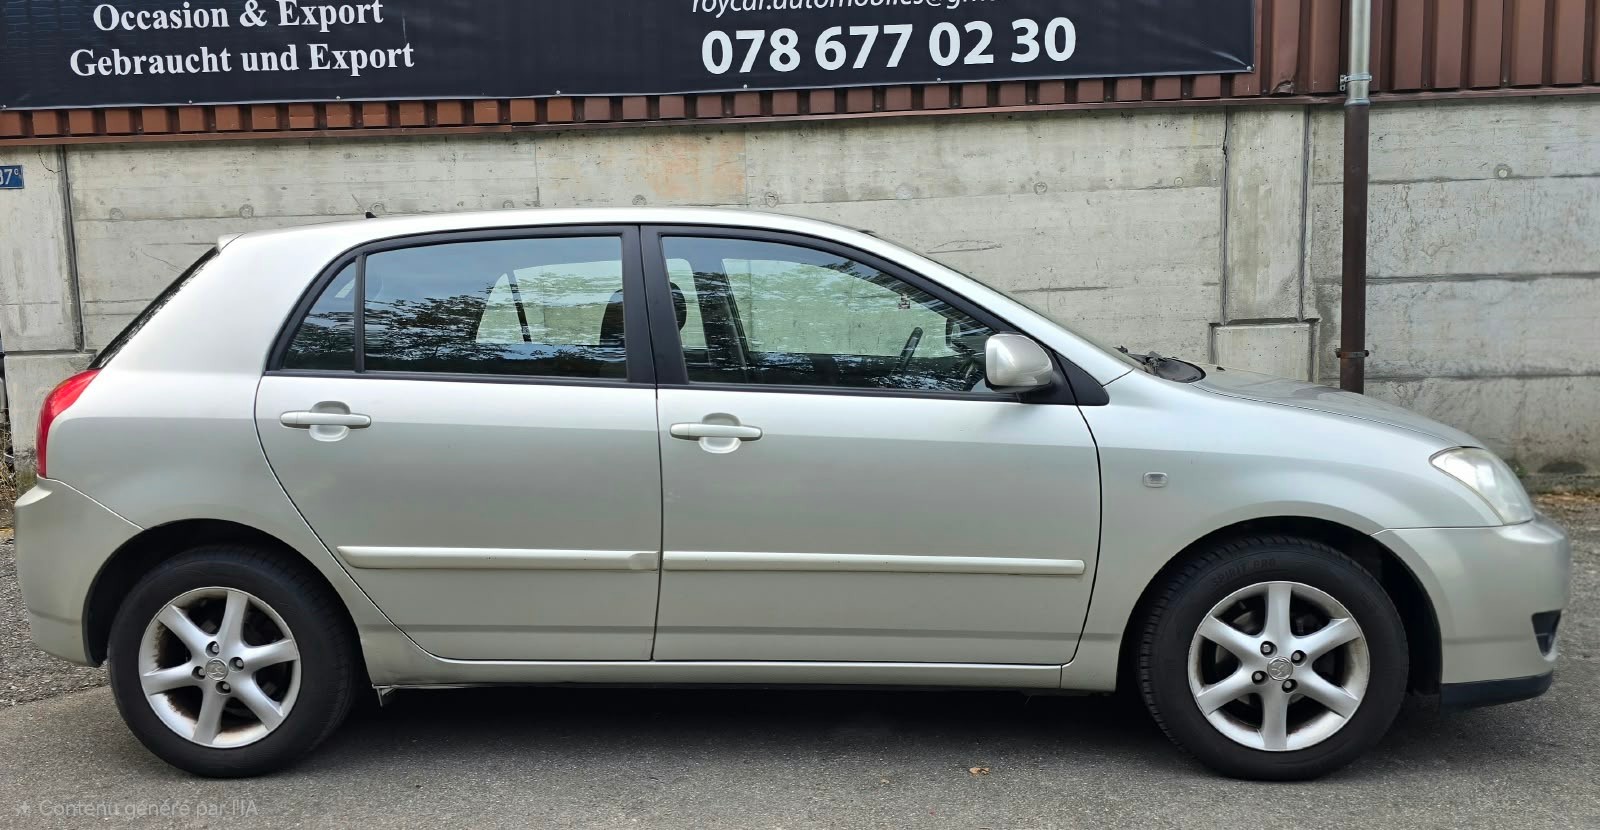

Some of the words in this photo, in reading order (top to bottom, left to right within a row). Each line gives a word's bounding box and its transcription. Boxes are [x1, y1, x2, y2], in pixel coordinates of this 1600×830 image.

[92, 2, 230, 30] Occasion
[239, 0, 268, 27] &
[275, 0, 384, 32] Export
[70, 47, 232, 76] Gebraucht
[240, 43, 300, 71] und
[306, 42, 415, 77] Export
[701, 28, 801, 75] 078
[814, 24, 913, 70] 677
[928, 20, 995, 66] 02
[1010, 16, 1077, 63] 30
